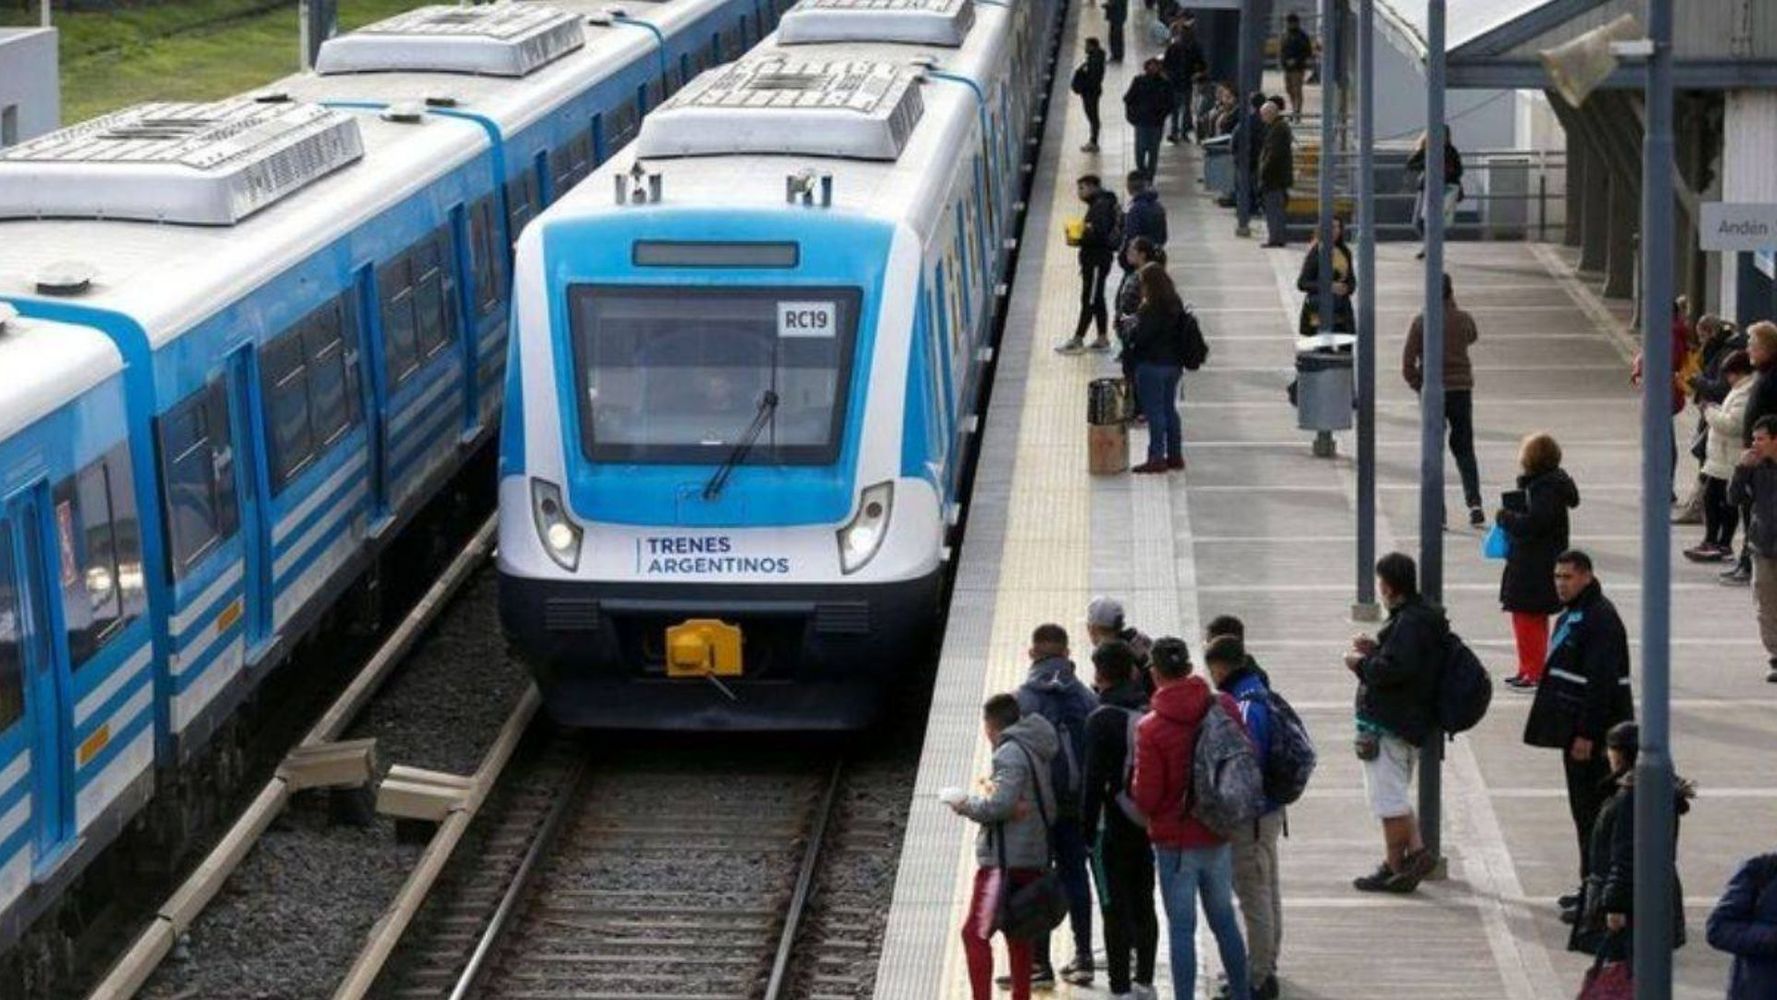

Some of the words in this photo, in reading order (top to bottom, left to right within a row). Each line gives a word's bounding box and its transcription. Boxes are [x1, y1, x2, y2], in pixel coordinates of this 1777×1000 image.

[785, 310, 827, 328] RC19
[648, 537, 731, 554] TRENES
[648, 557, 789, 573] ARGENTINOS
